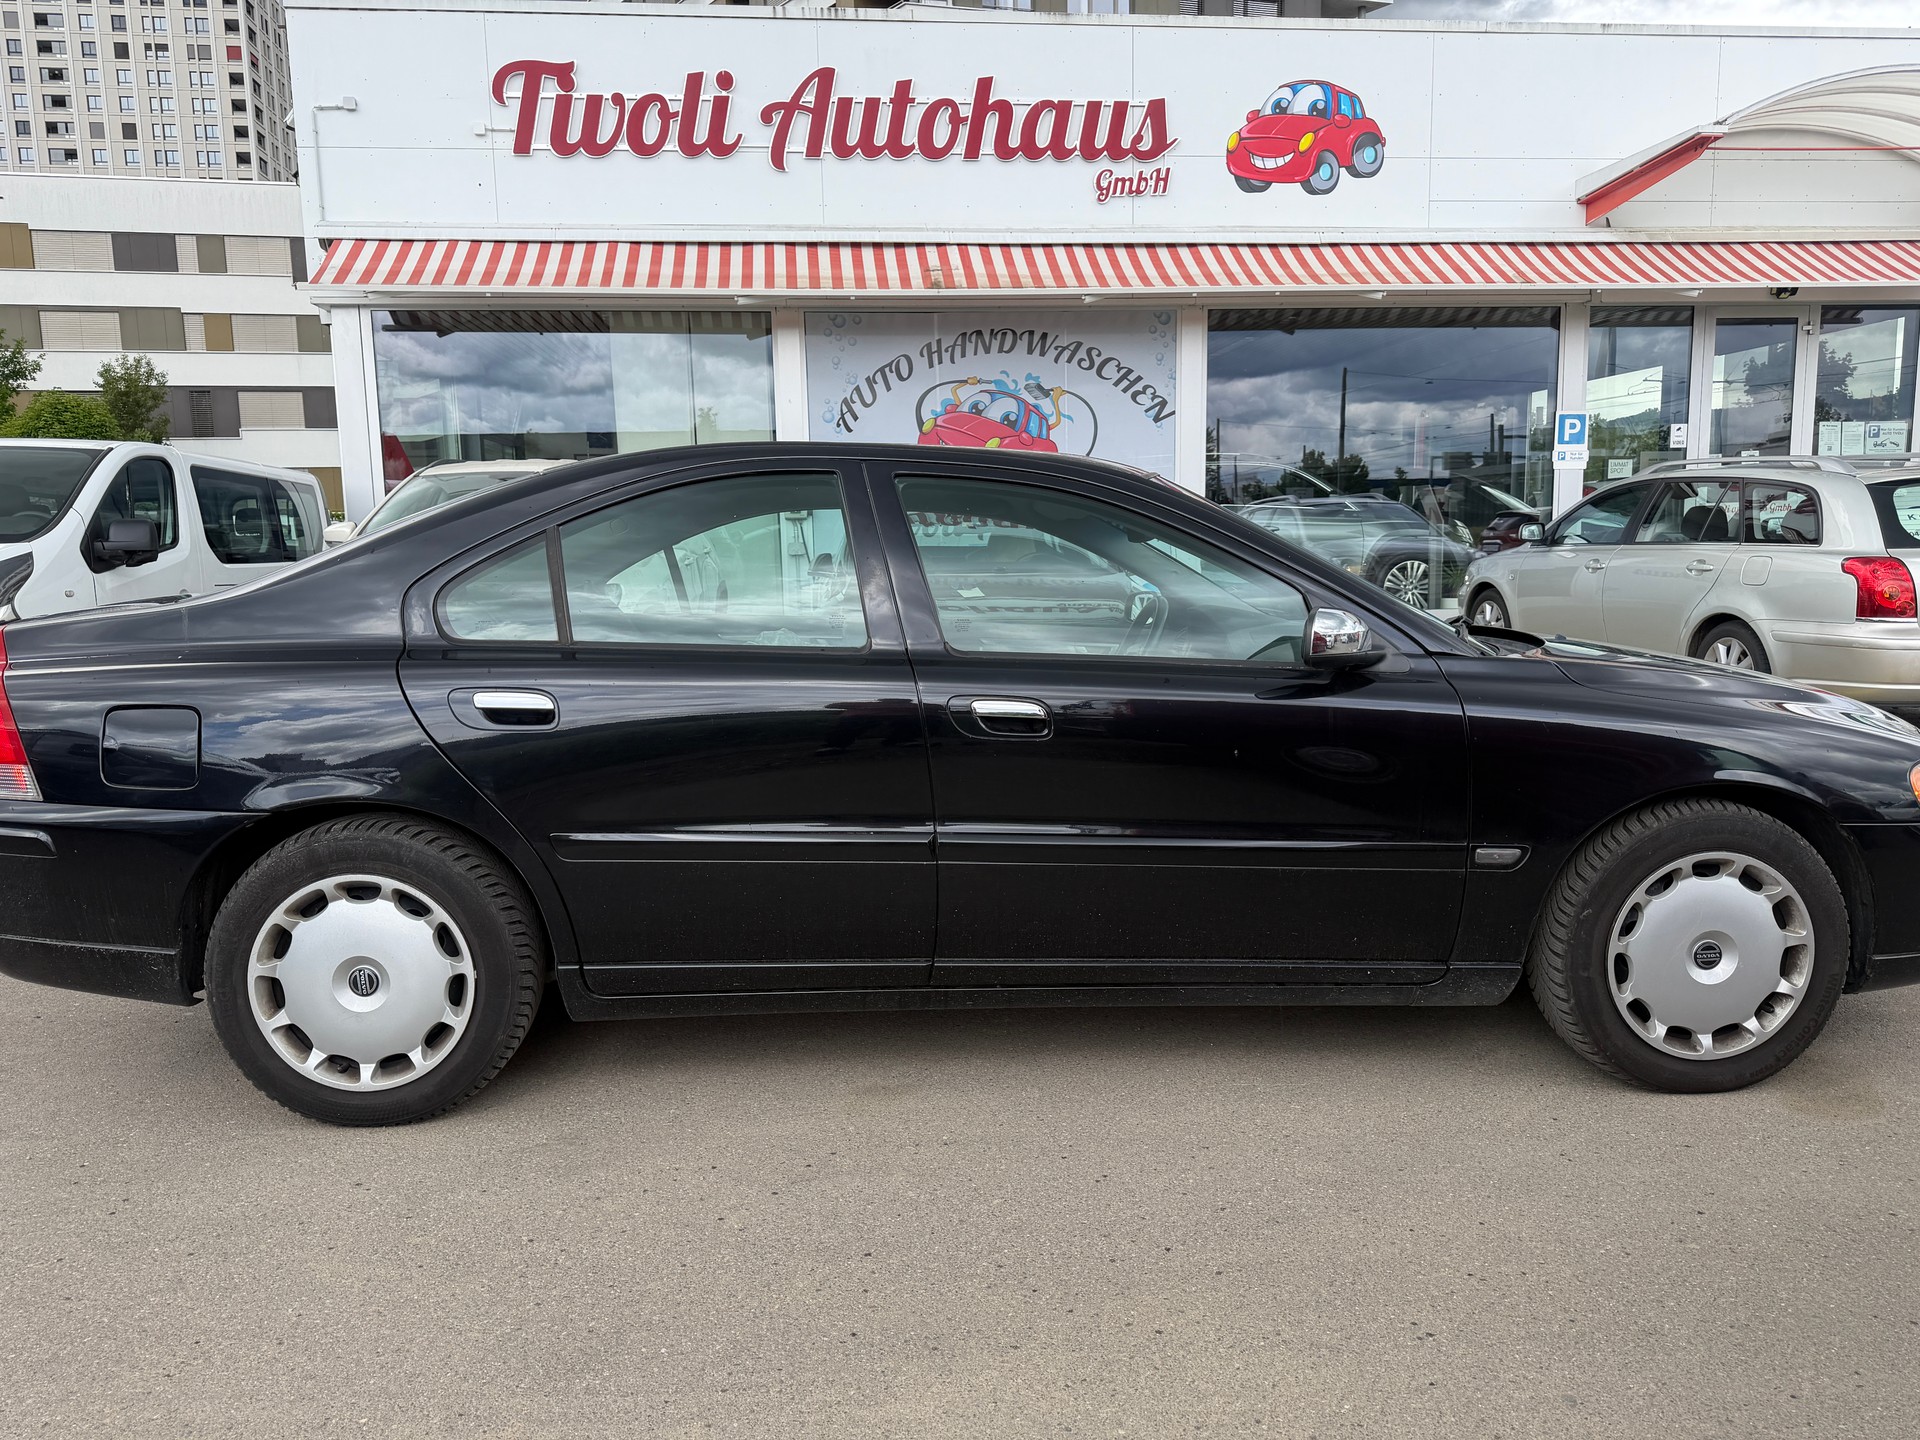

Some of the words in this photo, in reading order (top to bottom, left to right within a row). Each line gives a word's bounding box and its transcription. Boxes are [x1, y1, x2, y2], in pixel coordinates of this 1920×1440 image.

[492, 59, 742, 157] Tivoli
[760, 67, 1178, 171] Autohaus
[1094, 167, 1172, 203] GmbH
[836, 353, 914, 433] AUTO
[919, 327, 1176, 425] HANDWASCHEN
[1563, 418, 1582, 442] P
[359, 970, 367, 995] VOLVO
